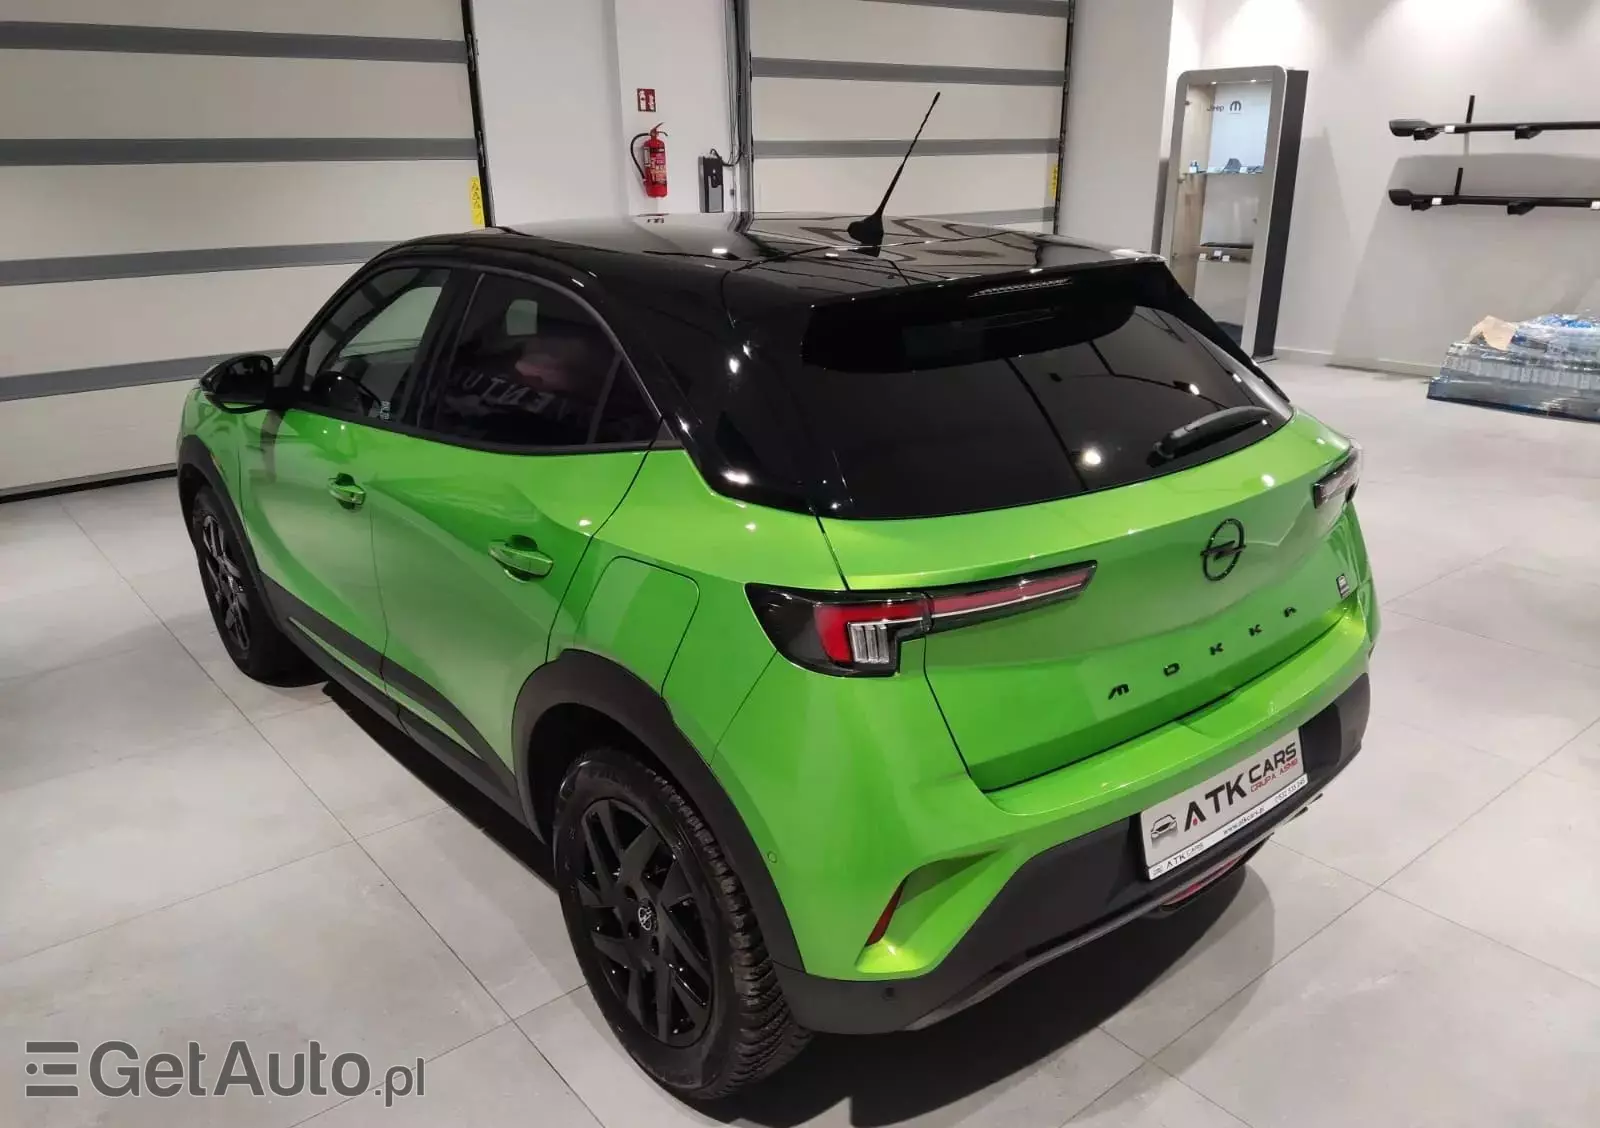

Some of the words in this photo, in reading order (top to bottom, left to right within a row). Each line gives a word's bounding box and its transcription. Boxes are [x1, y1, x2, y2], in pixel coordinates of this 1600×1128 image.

[1108, 606, 1297, 700] MOKKA
[1183, 771, 1248, 832] ATK
[1248, 742, 1298, 784] CARS
[1250, 773, 1277, 793] GRUPA
